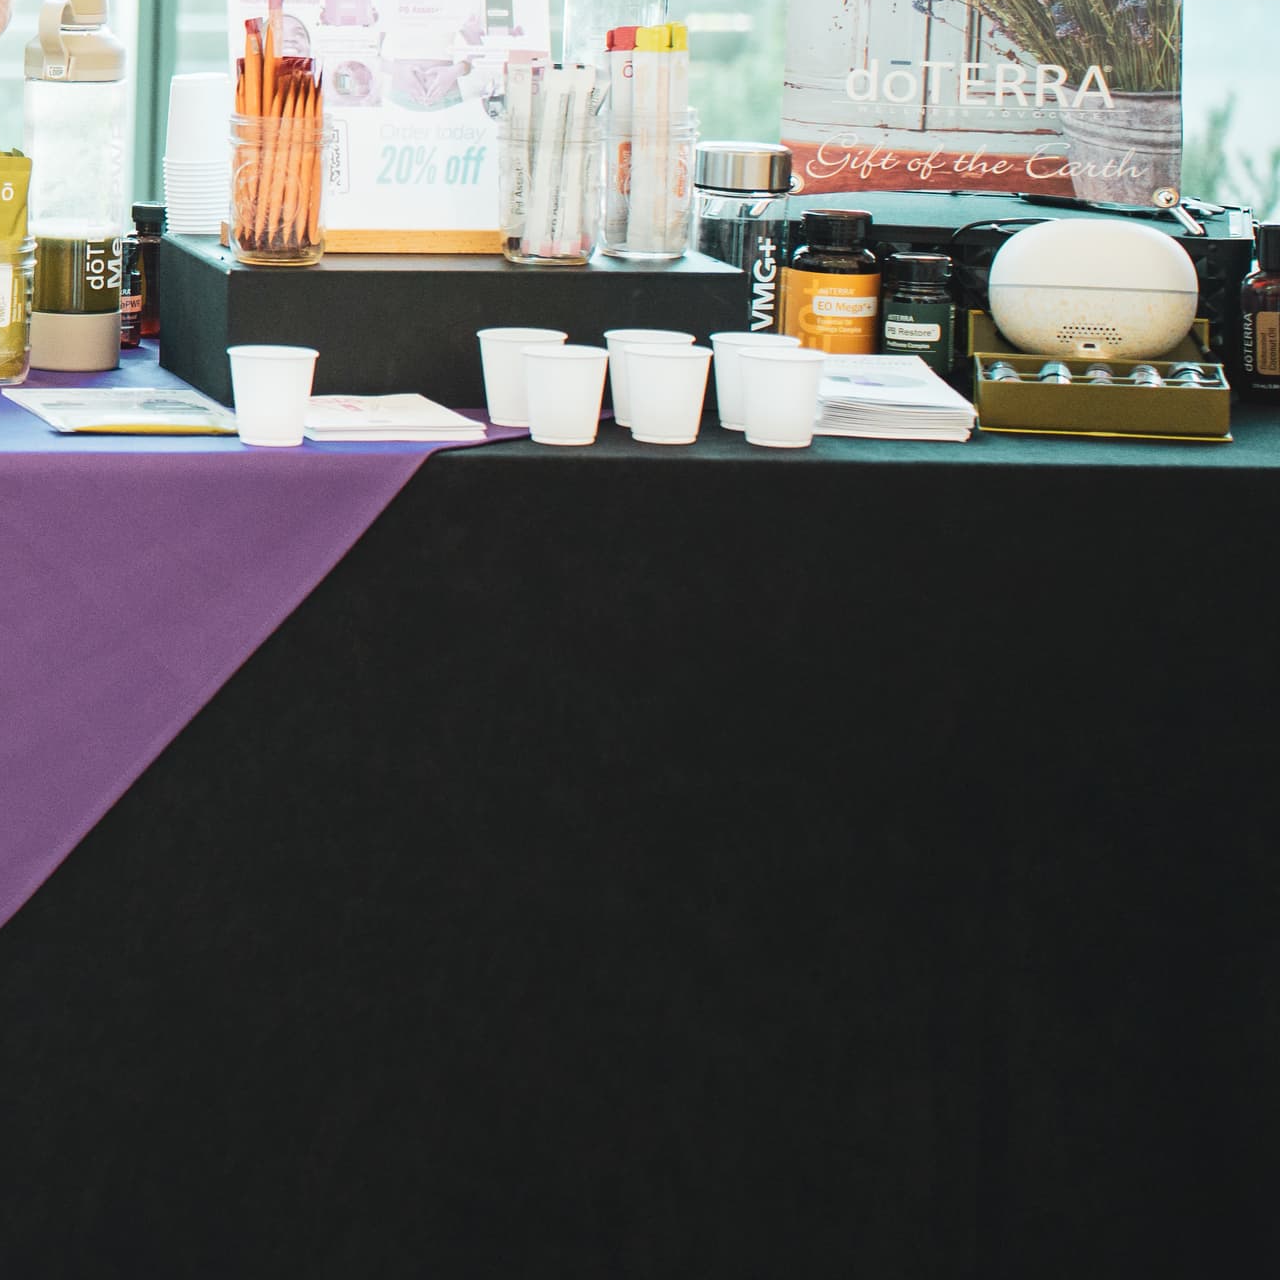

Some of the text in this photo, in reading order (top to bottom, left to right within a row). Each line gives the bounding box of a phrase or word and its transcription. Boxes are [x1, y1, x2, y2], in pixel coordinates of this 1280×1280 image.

[435, 122, 487, 145] today
[375, 144, 488, 187] 20% off
[805, 131, 1151, 184] Gift of the Earth
[751, 237, 777, 332] VMG+
[816, 300, 833, 311] EO
[898, 326, 933, 337] Restore
[1267, 327, 1276, 371] Coconut Oil
